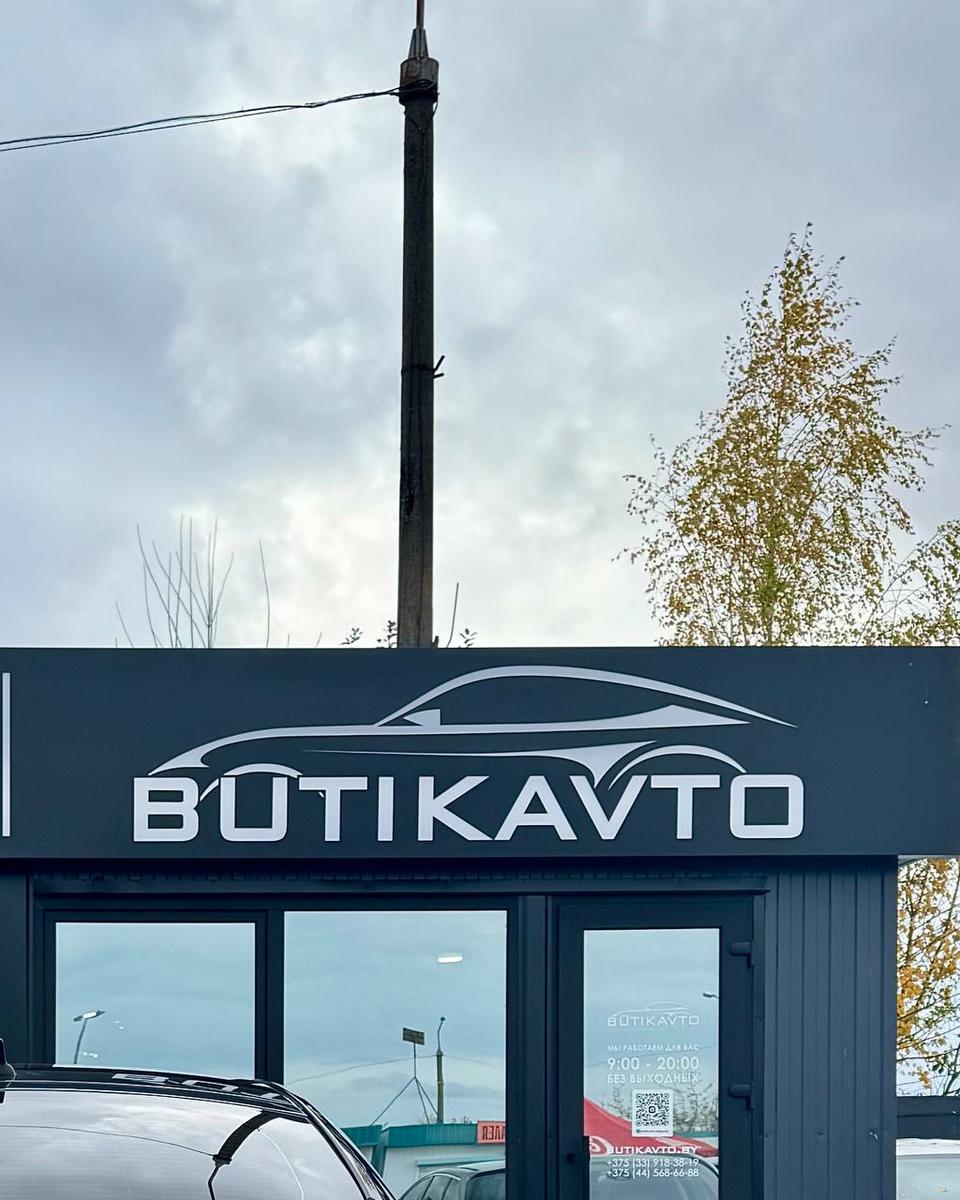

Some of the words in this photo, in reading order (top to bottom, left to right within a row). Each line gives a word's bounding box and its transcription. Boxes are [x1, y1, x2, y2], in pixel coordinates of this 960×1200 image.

[133, 774, 805, 842] BUTIKAVTO
[608, 1015, 700, 1027] BUTIKAVTO
[607, 1057, 640, 1070] 9:00
[656, 1056, 700, 1070] 20:00
[607, 1073, 626, 1084] БЕЗ
[629, 1073, 699, 1084] ВЫХОДНЫХ
[607, 1146, 701, 1154] BUTIKAVTO.BY
[607, 1159, 629, 1167] +375
[632, 1158, 650, 1169] (33)
[653, 1158, 699, 1167] 918-38-19
[607, 1169, 629, 1177] +375
[632, 1168, 650, 1179] (44)
[653, 1168, 699, 1177] 568-66-88
